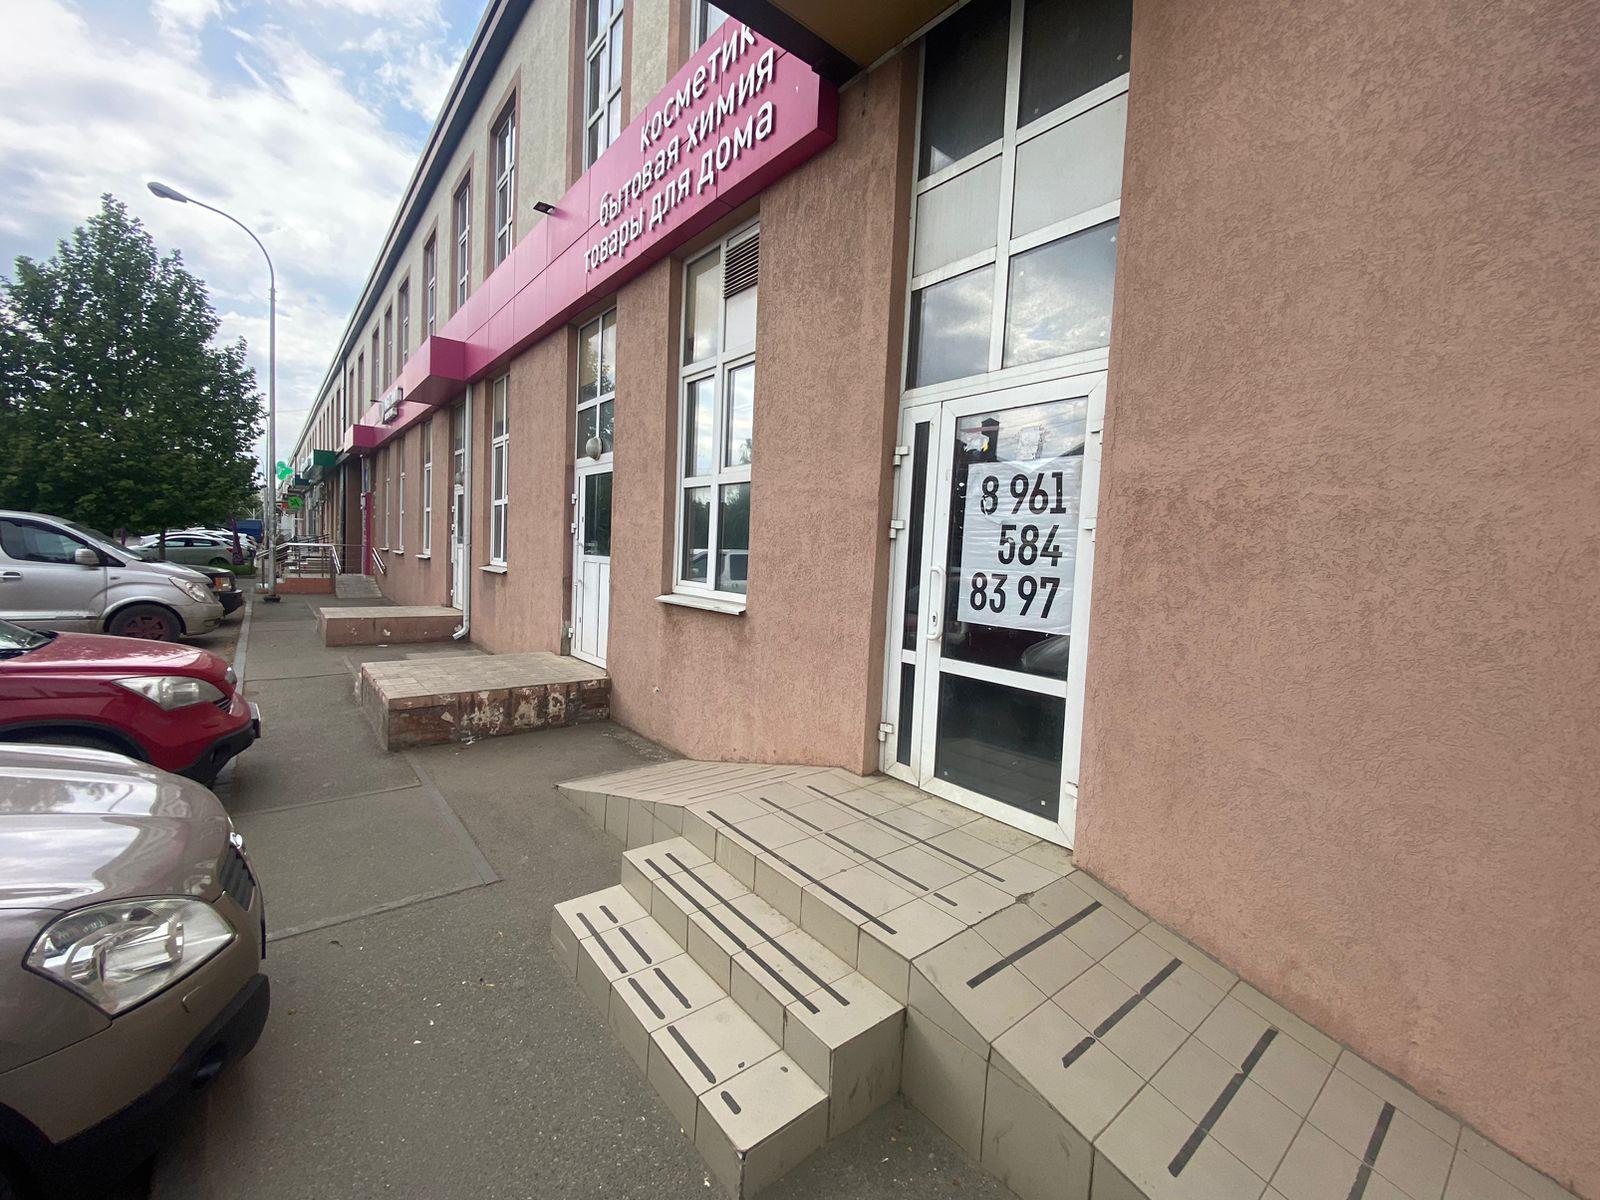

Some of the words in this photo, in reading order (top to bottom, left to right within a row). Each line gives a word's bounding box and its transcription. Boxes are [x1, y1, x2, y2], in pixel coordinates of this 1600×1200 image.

[600, 135, 680, 227] бытовая
[686, 47, 774, 152] химия
[584, 207, 644, 273] товары
[649, 167, 690, 231] для
[697, 101, 773, 194] дома
[980, 475, 999, 515] 8
[1010, 472, 1066, 514] 961
[998, 524, 1063, 566] 584
[970, 572, 1008, 613] 83
[1018, 575, 1060, 618] 97
